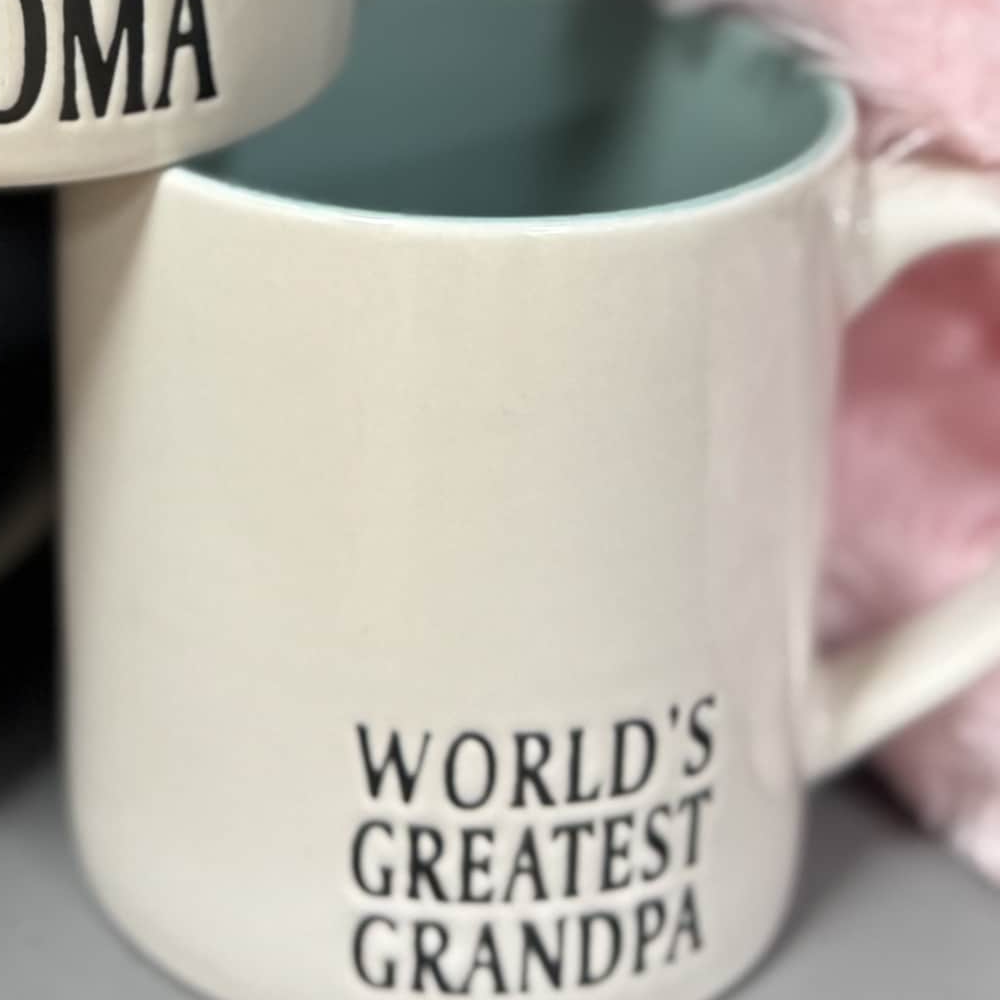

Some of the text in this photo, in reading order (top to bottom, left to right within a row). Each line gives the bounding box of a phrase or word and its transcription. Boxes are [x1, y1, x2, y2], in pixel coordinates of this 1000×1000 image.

[356, 695, 716, 811] WORLD'S
[351, 788, 712, 904] GREATEST
[352, 884, 704, 995] GRANDPA
